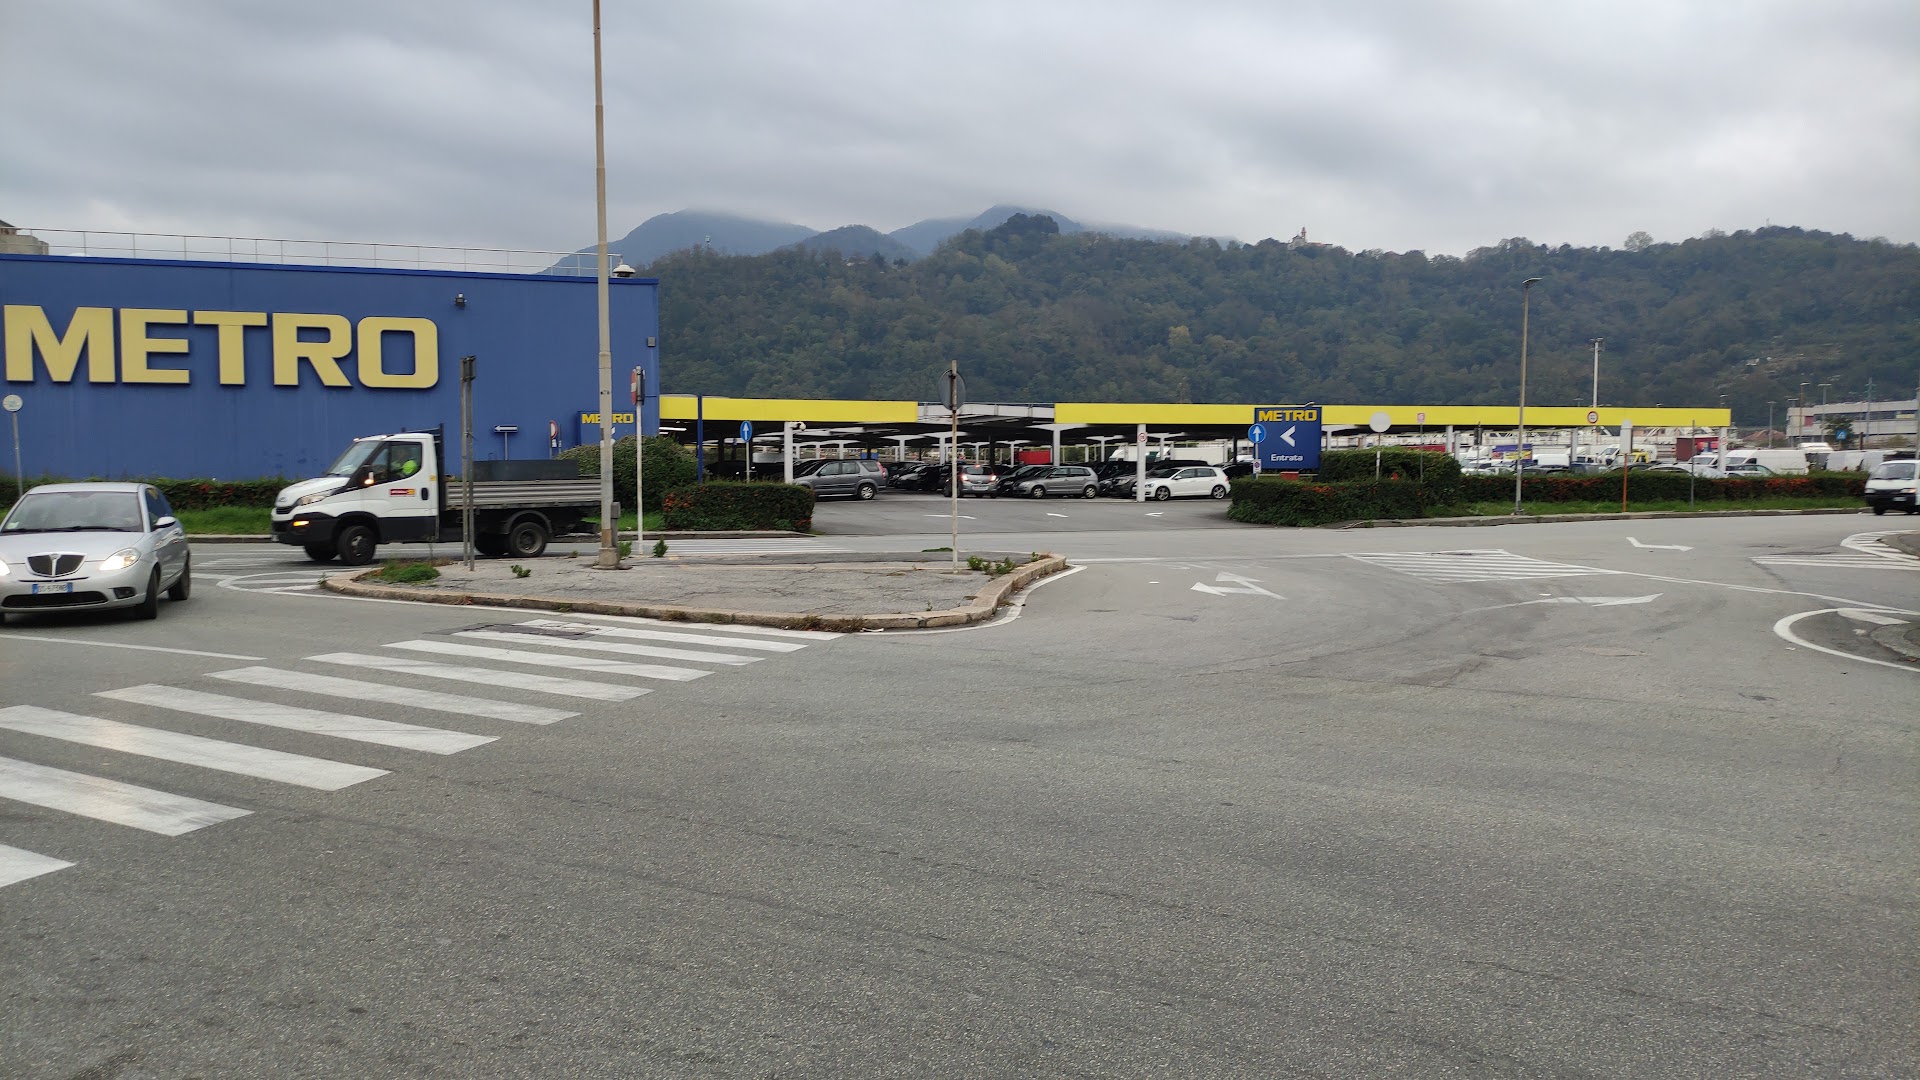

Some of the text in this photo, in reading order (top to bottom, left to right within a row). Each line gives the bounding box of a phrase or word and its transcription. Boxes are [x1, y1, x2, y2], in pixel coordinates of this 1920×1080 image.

[3, 304, 439, 388] METRO
[582, 413, 634, 424] MERO
[1259, 410, 1317, 421] METRO
[1270, 453, 1303, 461] Entrata
